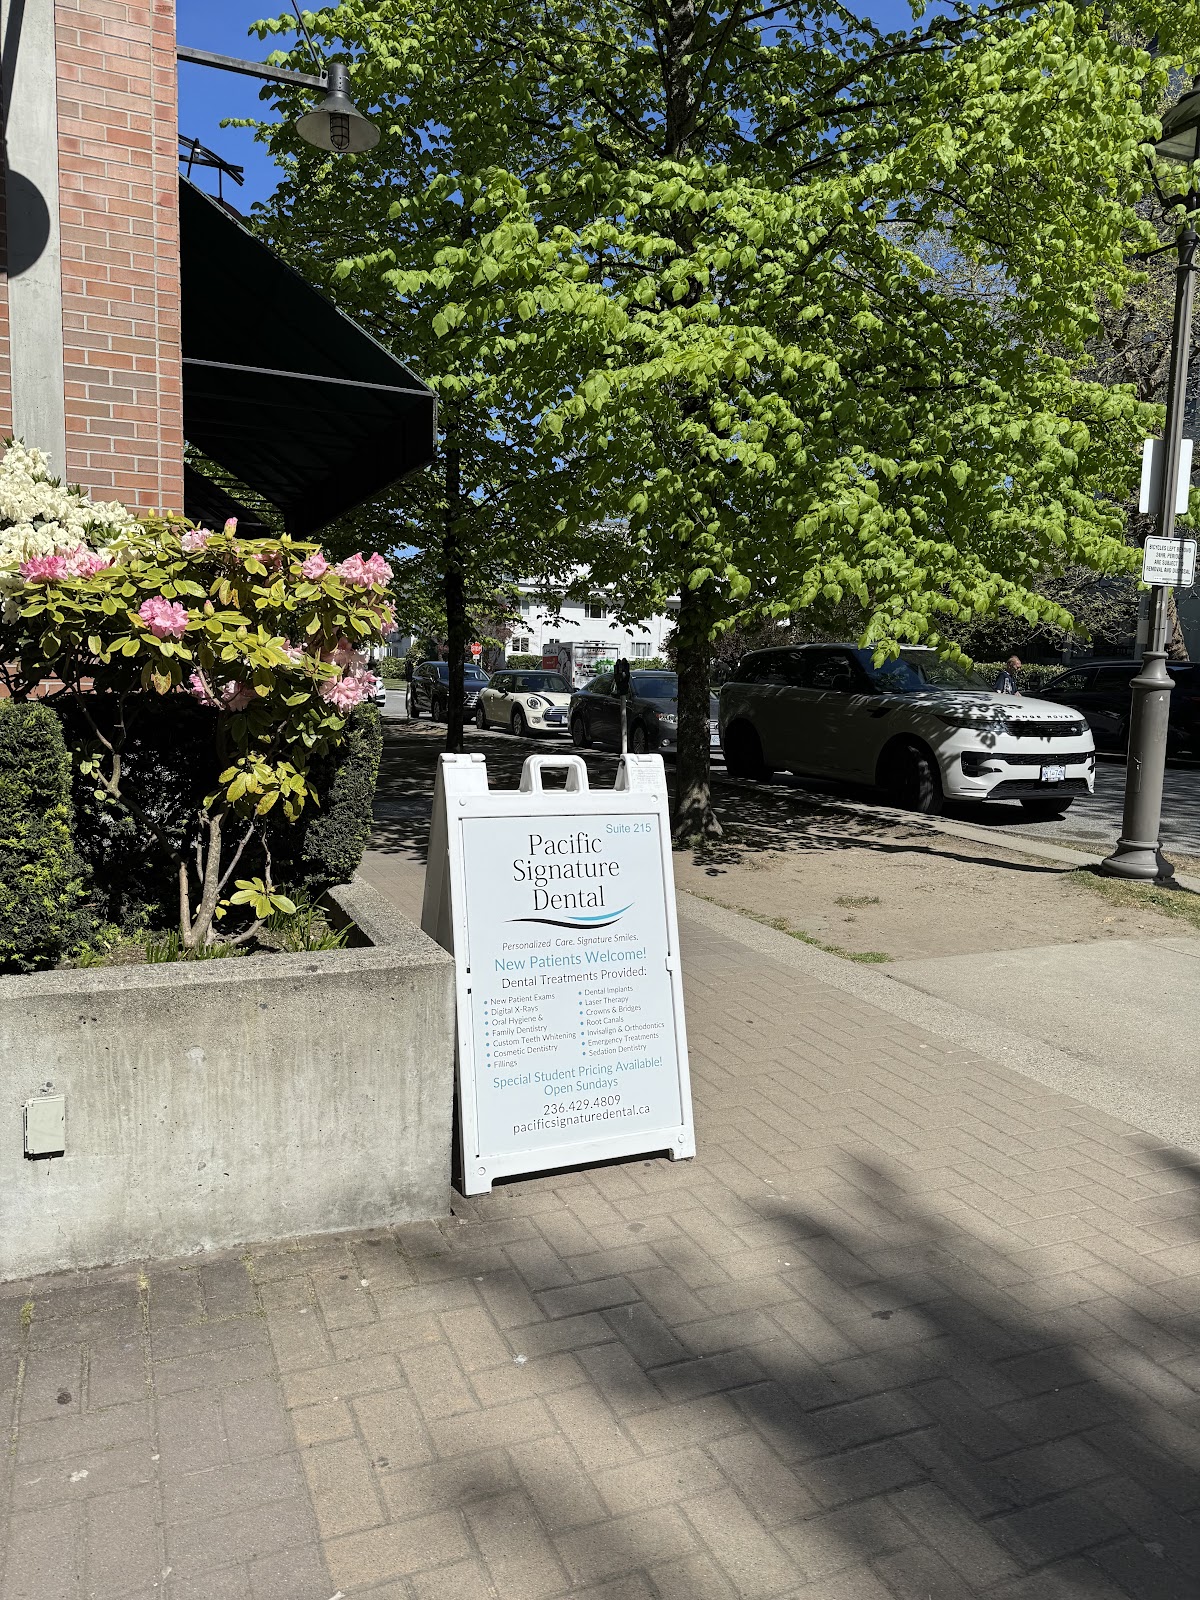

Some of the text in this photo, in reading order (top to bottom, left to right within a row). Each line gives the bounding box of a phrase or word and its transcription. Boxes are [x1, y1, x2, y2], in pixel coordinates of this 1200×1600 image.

[606, 823, 652, 834] Suite 215
[528, 831, 603, 856] Pacific
[513, 858, 620, 888] Signature
[532, 885, 606, 911] Dental
[502, 933, 639, 951] Personalized Care. Signature Smiles.
[494, 947, 647, 972] New Patients Welcome!
[501, 966, 647, 989] Dental Treatments Provided:
[584, 985, 634, 996] Dental Implants
[490, 993, 555, 1006] New Patient Exams
[585, 996, 629, 1006] Laser Therapy
[491, 1005, 539, 1016] Digital X-Rays
[585, 1004, 642, 1016] Crowns & Bridges
[491, 1013, 544, 1026] Oral Hygiene &
[586, 1015, 624, 1026] Root Canals
[492, 1024, 548, 1037] Family Dentistry
[587, 1021, 665, 1036] Invisalign & Orthodontics
[492, 1031, 577, 1047] Custom Teeth Whitening
[587, 1033, 659, 1047] Emergency Treatments
[493, 1044, 559, 1058] Cosmetic Dentistry
[588, 1044, 647, 1057] Sedation Dentistry
[493, 1060, 518, 1069] Fillings
[493, 1056, 663, 1089] Special Student Pricing Available!
[544, 1077, 619, 1097] Open Sundays
[543, 1094, 622, 1116] 236.429.4809
[513, 1104, 650, 1136] pacificsignaturedental.ca
